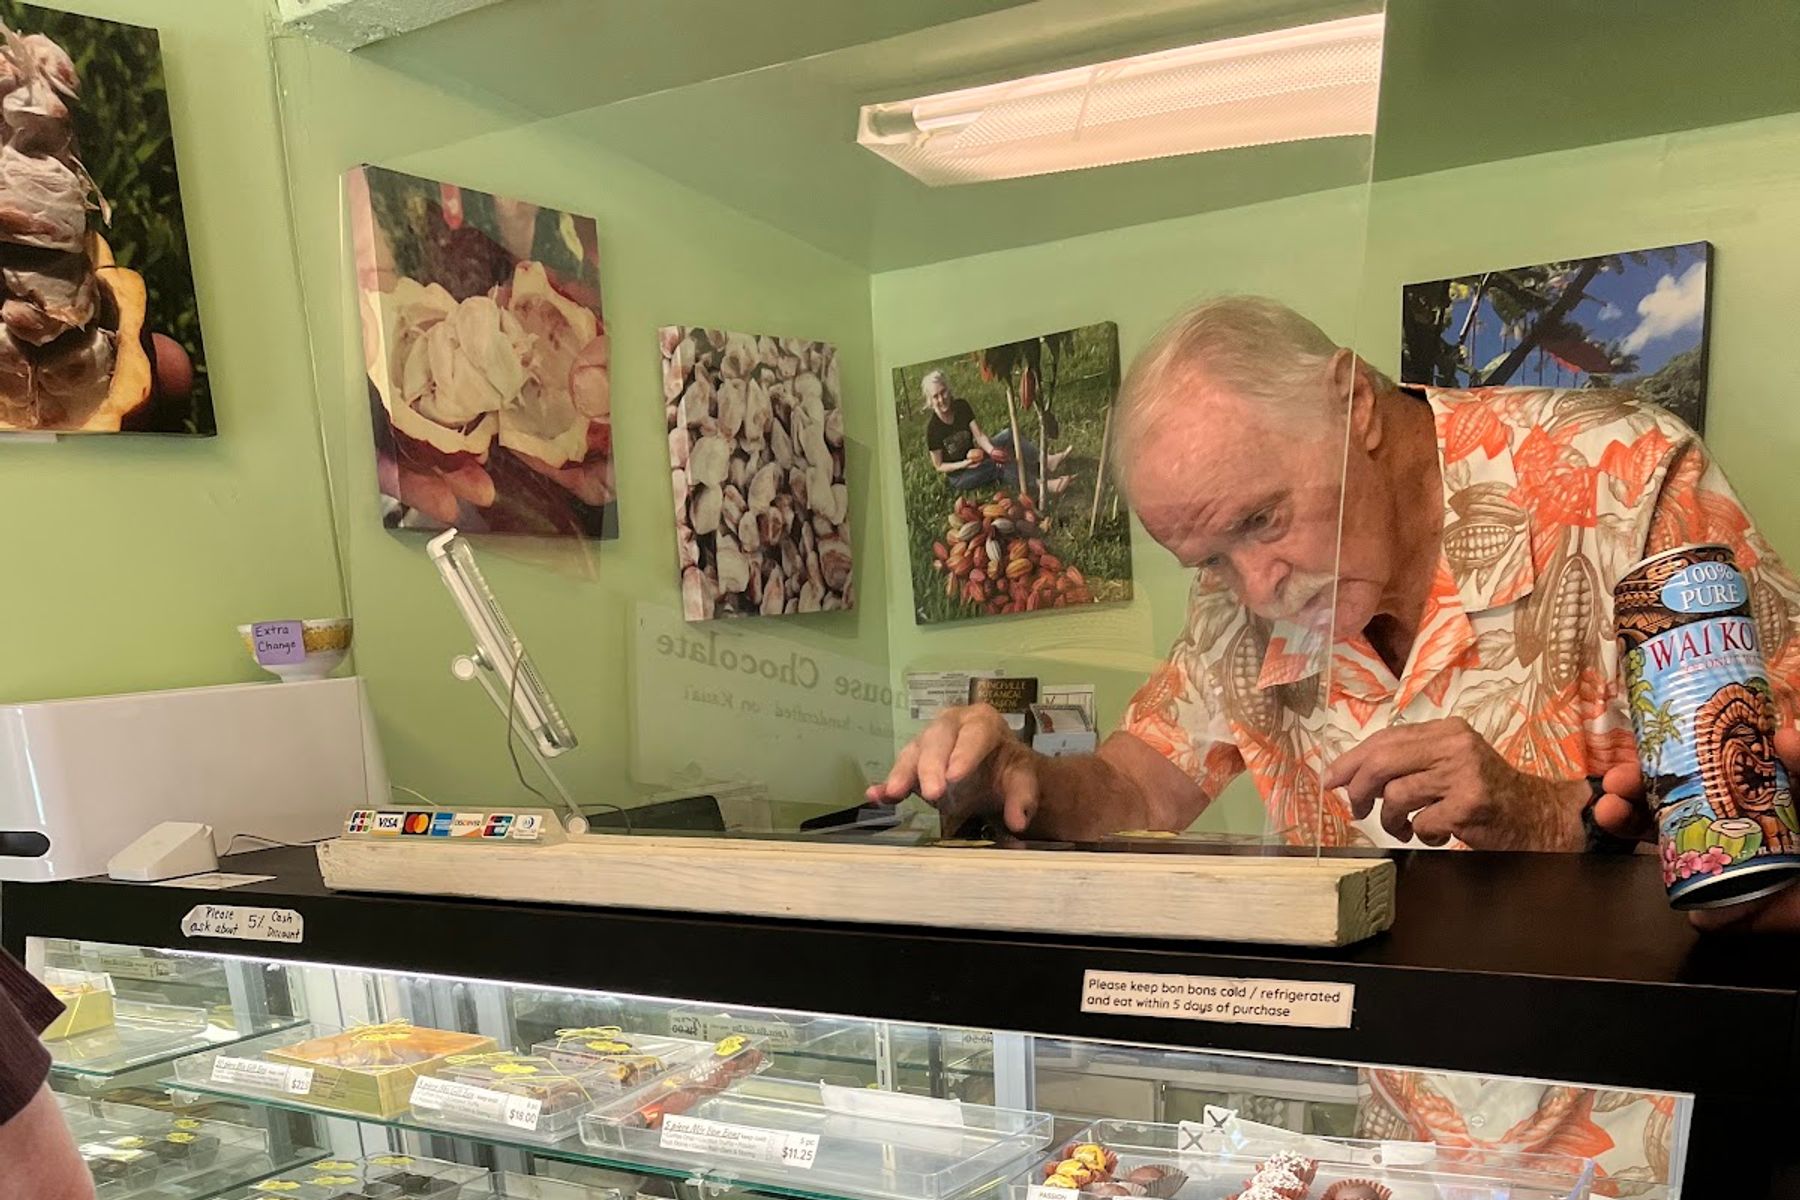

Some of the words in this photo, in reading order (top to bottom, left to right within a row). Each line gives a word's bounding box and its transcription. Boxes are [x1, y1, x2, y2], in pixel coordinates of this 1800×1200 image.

[1682, 562, 1735, 587] 100%
[1680, 583, 1741, 612] PURE
[255, 625, 290, 637] Extra
[1721, 621, 1760, 653] KO
[258, 640, 297, 654] Change
[379, 817, 398, 828] VISA
[455, 819, 482, 827] DISCOVER
[205, 906, 234, 920] Please
[271, 910, 293, 923] Cash
[190, 921, 211, 932] ask
[215, 922, 239, 936] about
[248, 914, 265, 929] 5%
[267, 925, 301, 939] Discount
[1089, 978, 1128, 992] Please
[1130, 981, 1158, 994] keep
[1161, 982, 1185, 994] bon
[1187, 983, 1217, 996] bons
[1220, 986, 1247, 998] cold
[1250, 986, 1258, 999] /
[1260, 988, 1341, 1003] refrigerated
[1087, 994, 1110, 1006] and
[1113, 997, 1133, 1007] eat
[1136, 997, 1170, 1010] within
[1172, 999, 1181, 1010] 5
[1183, 1000, 1213, 1014] days
[1216, 1002, 1231, 1013] of
[1232, 1004, 1291, 1018] purchase
[782, 1146, 813, 1161] $11.25
[1039, 1192, 1067, 1200] PASSION
